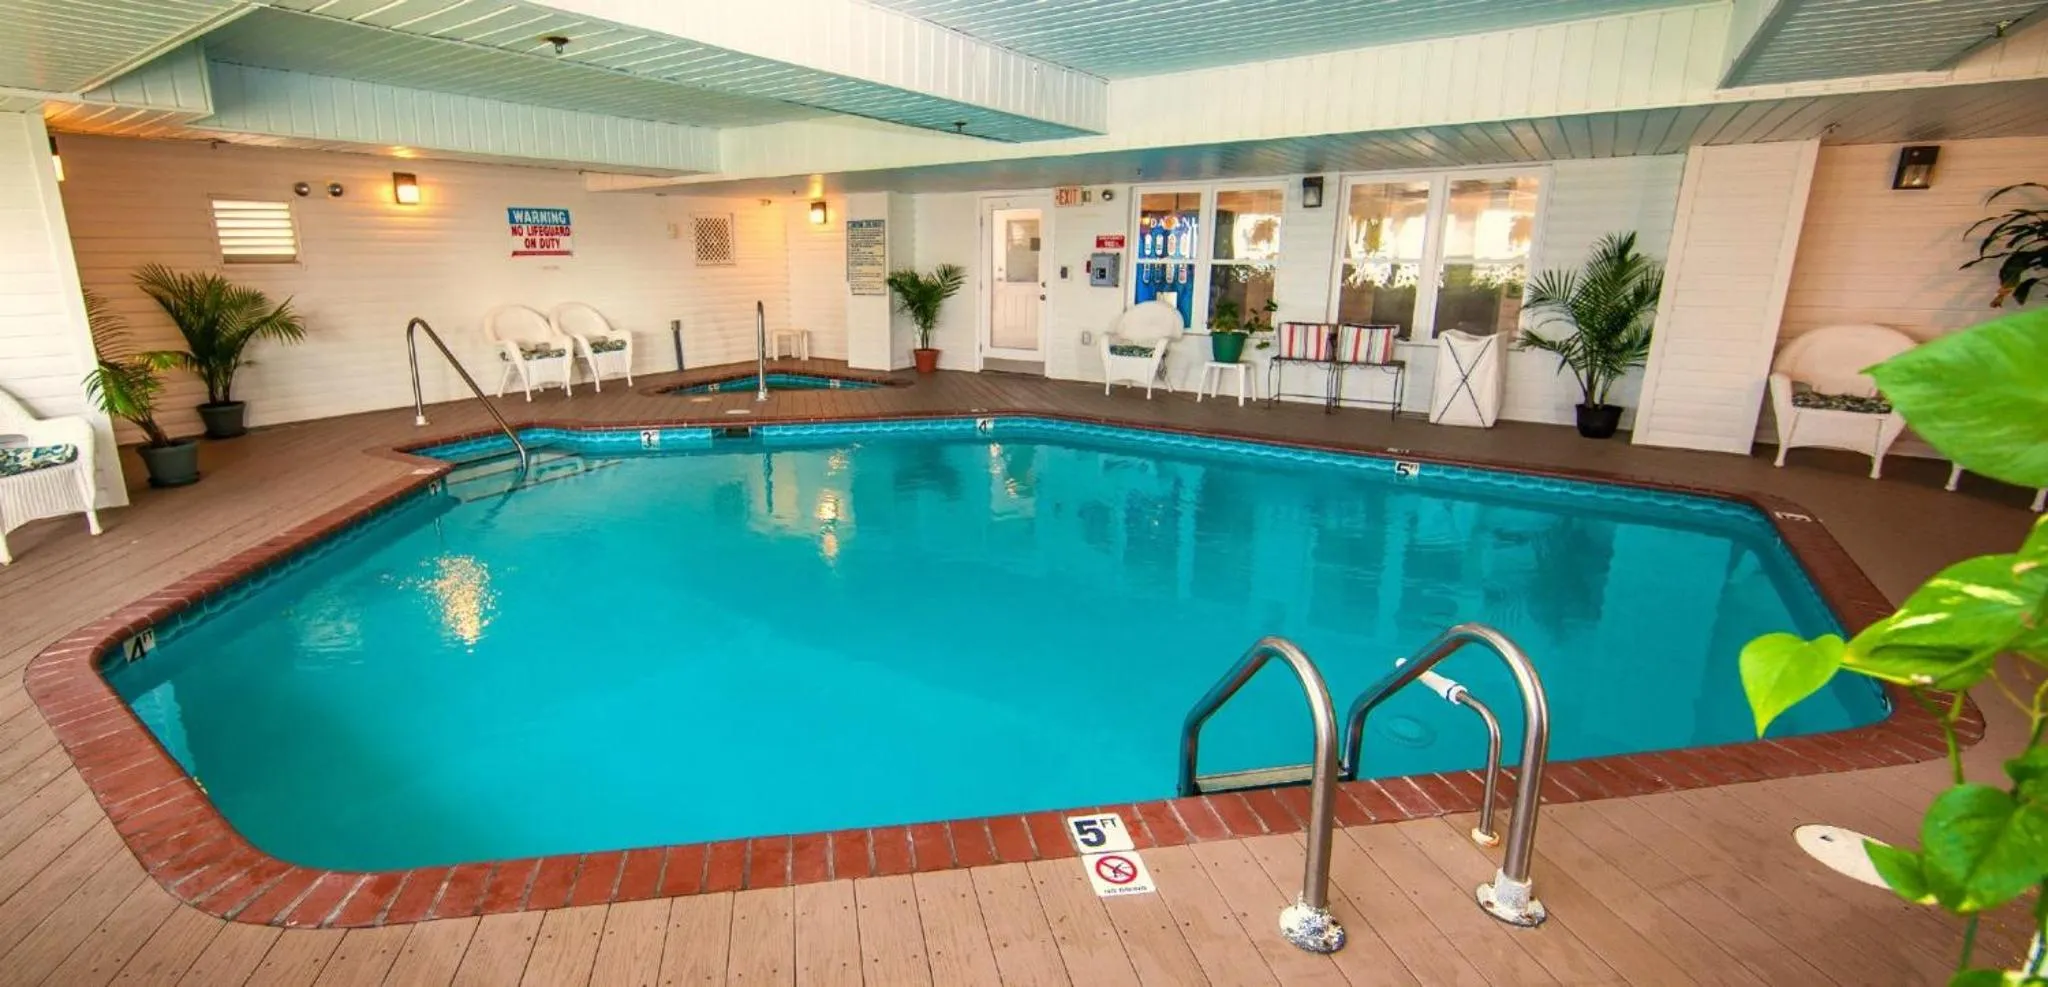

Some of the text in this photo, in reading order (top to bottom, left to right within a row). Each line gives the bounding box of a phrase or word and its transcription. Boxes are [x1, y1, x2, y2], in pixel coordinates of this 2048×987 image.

[1059, 188, 1078, 206] EXIT
[513, 209, 567, 225] WARNING
[511, 225, 571, 237] NO LIFEGUARD
[524, 238, 561, 249] ON DUTY
